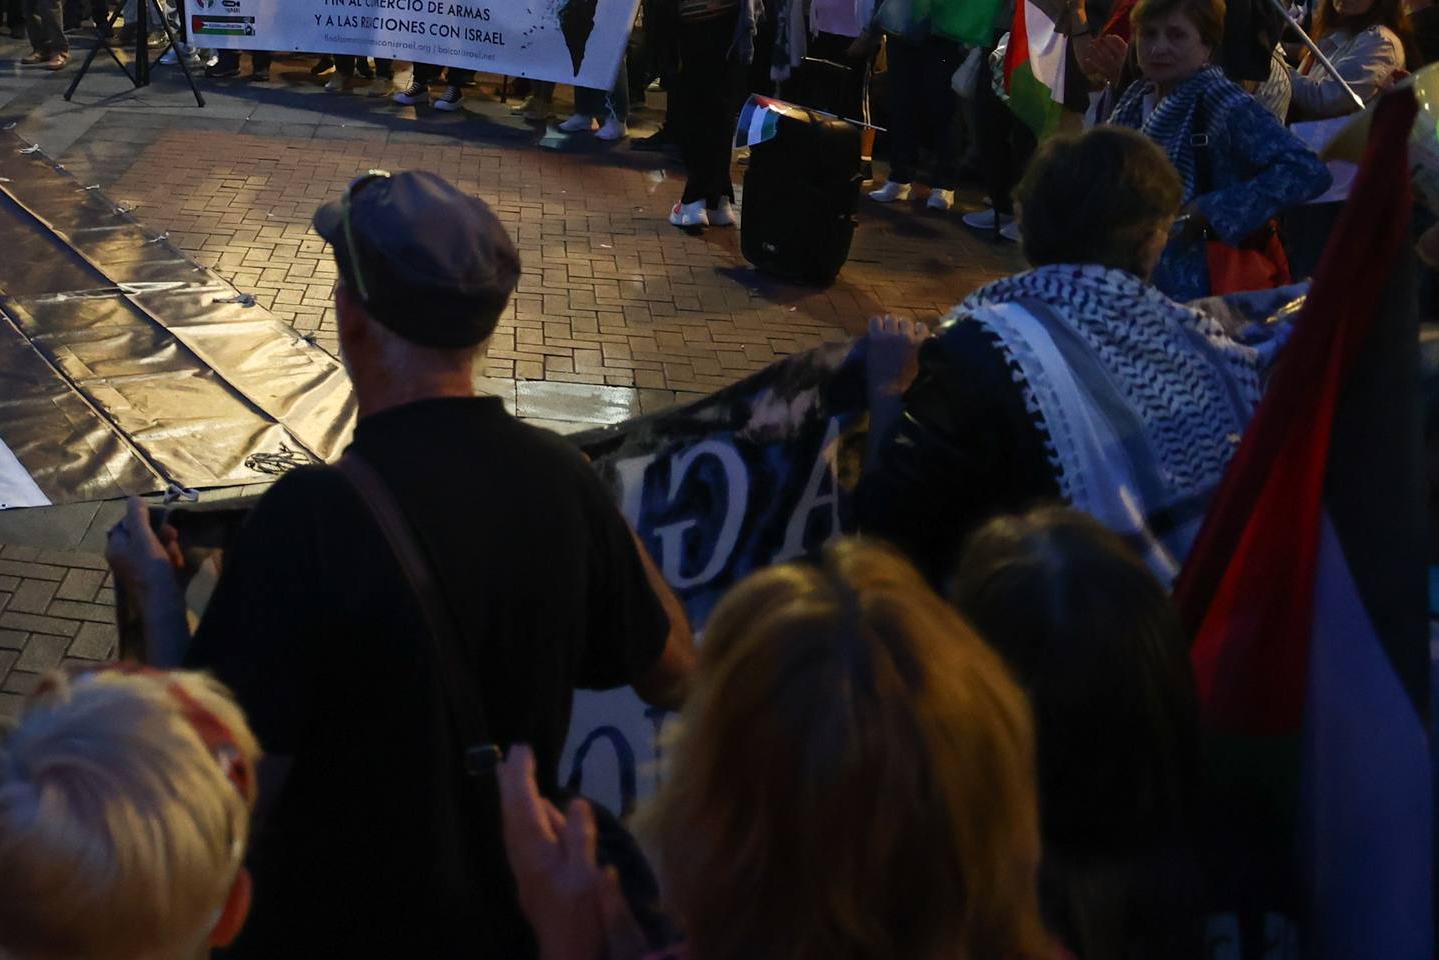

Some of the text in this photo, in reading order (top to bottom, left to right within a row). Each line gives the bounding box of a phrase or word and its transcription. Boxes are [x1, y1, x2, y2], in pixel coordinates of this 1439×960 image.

[428, 1, 444, 15] DE
[448, 4, 490, 22] ARMAS
[314, 14, 506, 46] Y A LAS RECIONES CON ISRAEL
